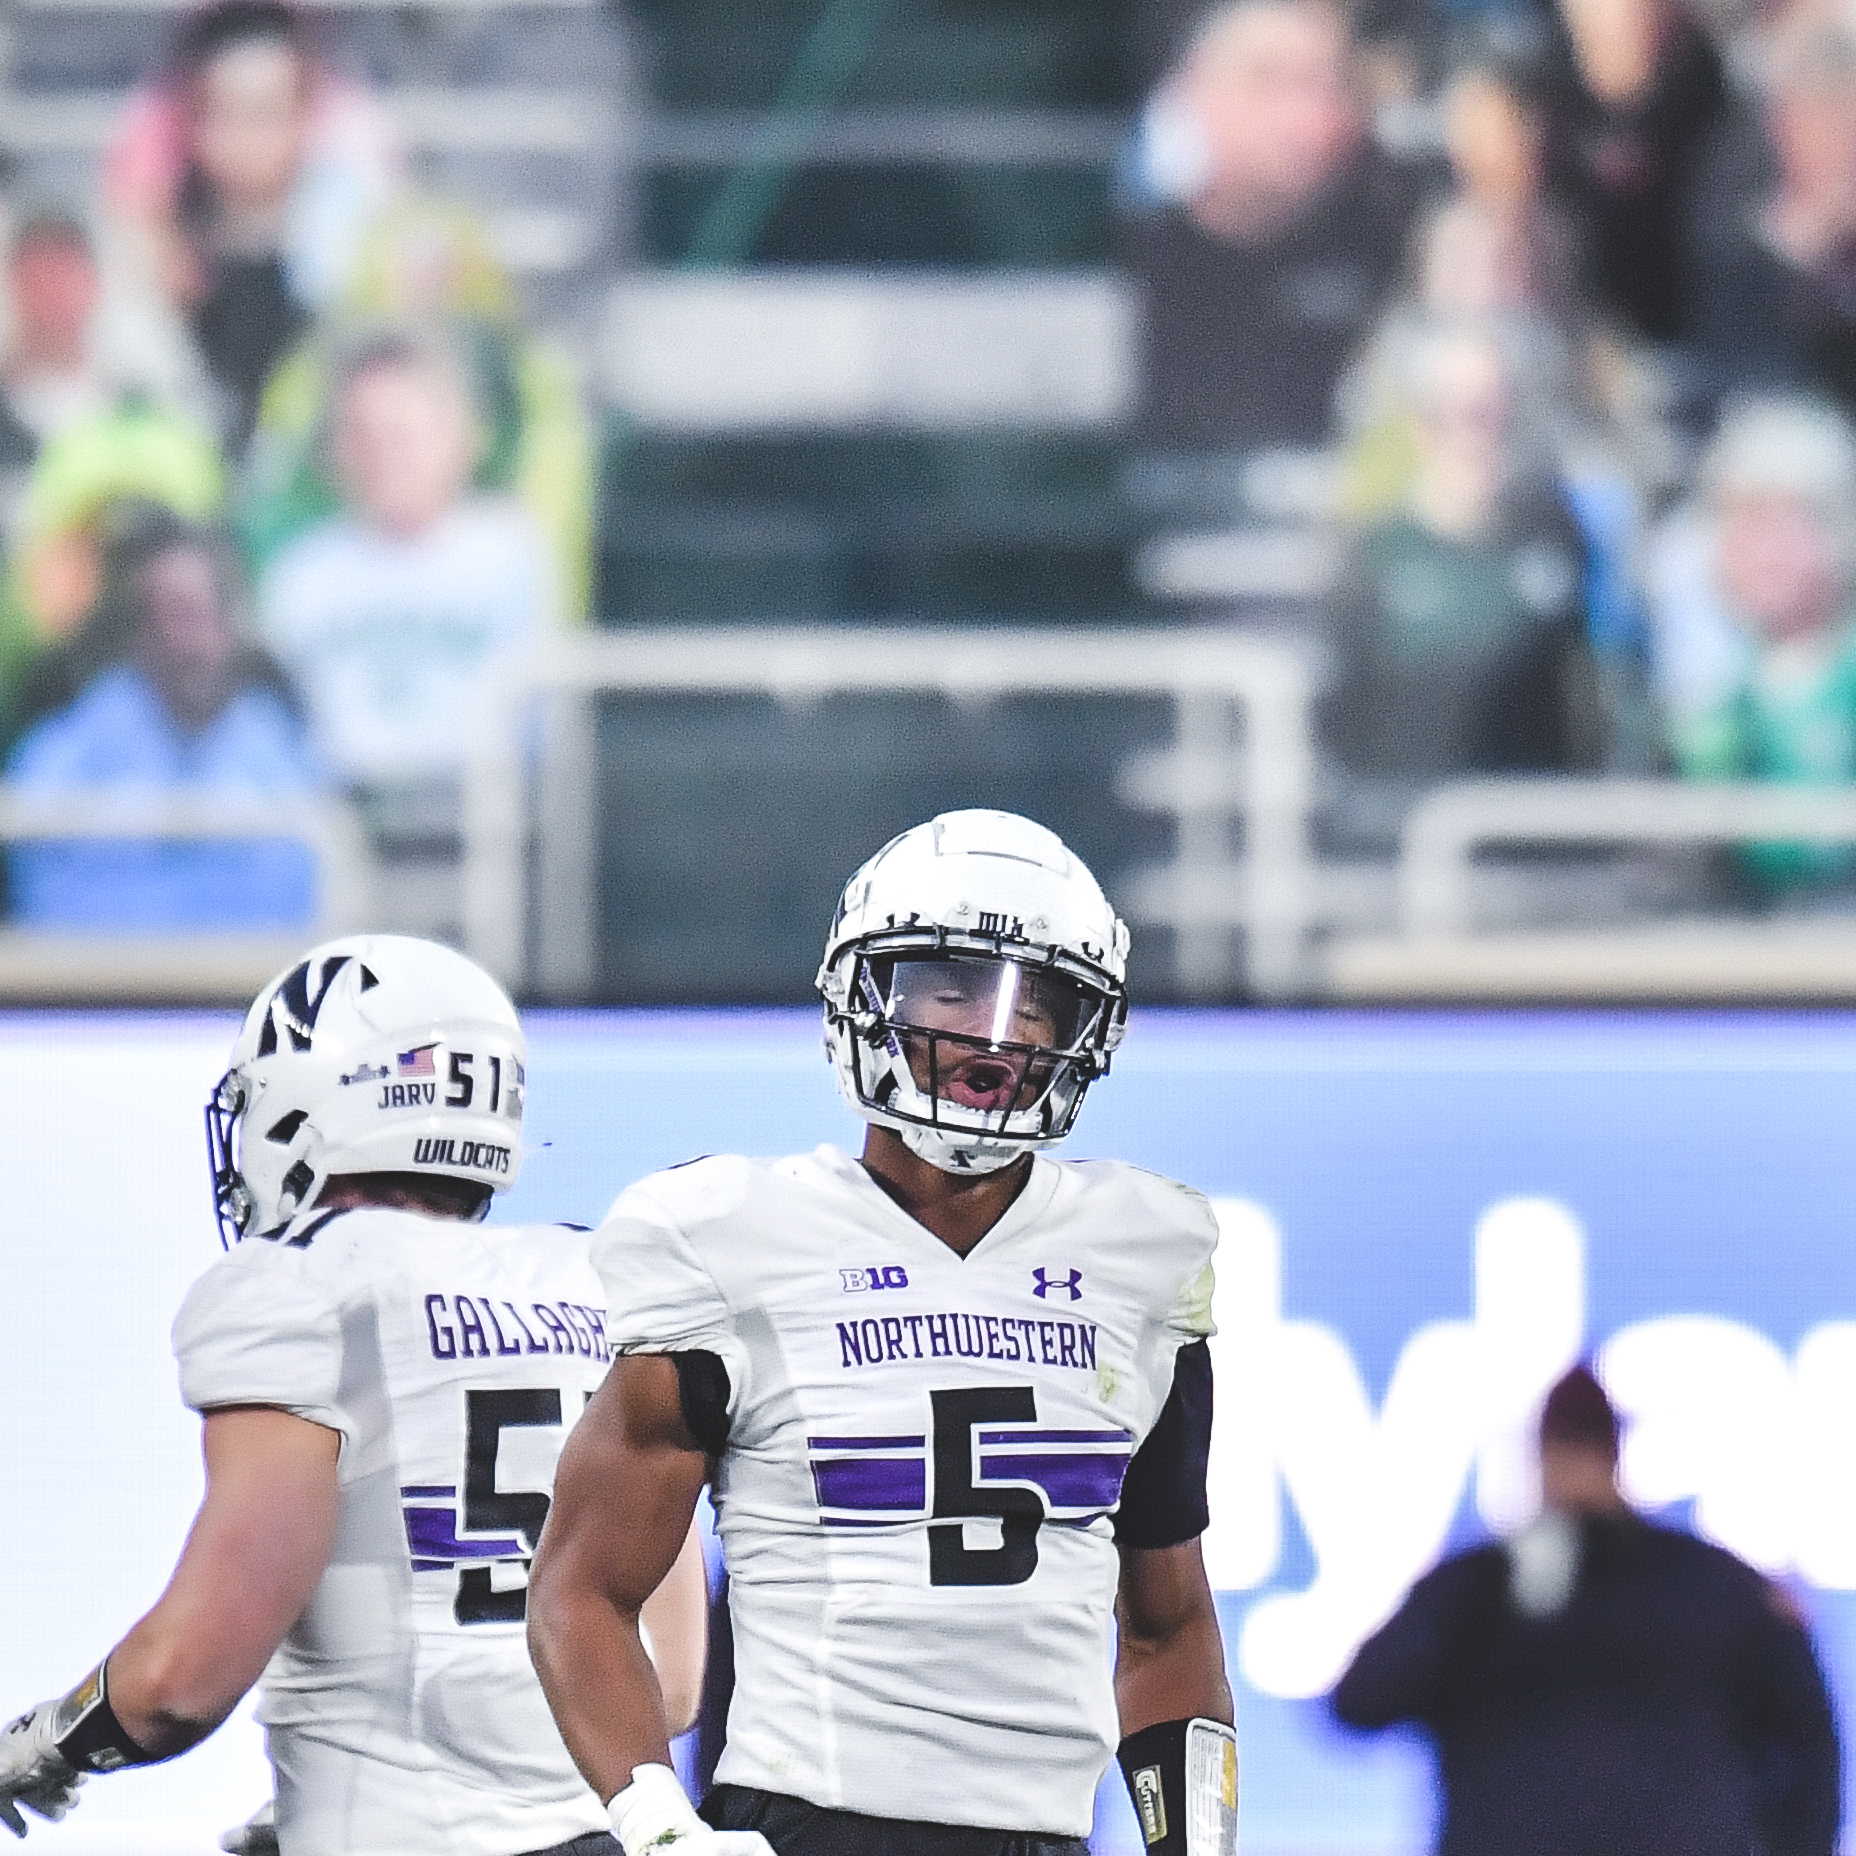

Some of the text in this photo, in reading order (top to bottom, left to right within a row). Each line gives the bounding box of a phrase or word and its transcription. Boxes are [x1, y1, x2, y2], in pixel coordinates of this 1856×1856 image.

[377, 1082, 436, 1109] JARV
[445, 1051, 501, 1113] 51
[413, 1138, 511, 1174] WILDCATS
[424, 1293, 610, 1364] GALLAGH
[835, 1312, 1098, 1371] NORTHWESTERN
[453, 1387, 597, 1626] 5
[929, 1386, 1046, 1589] 5
